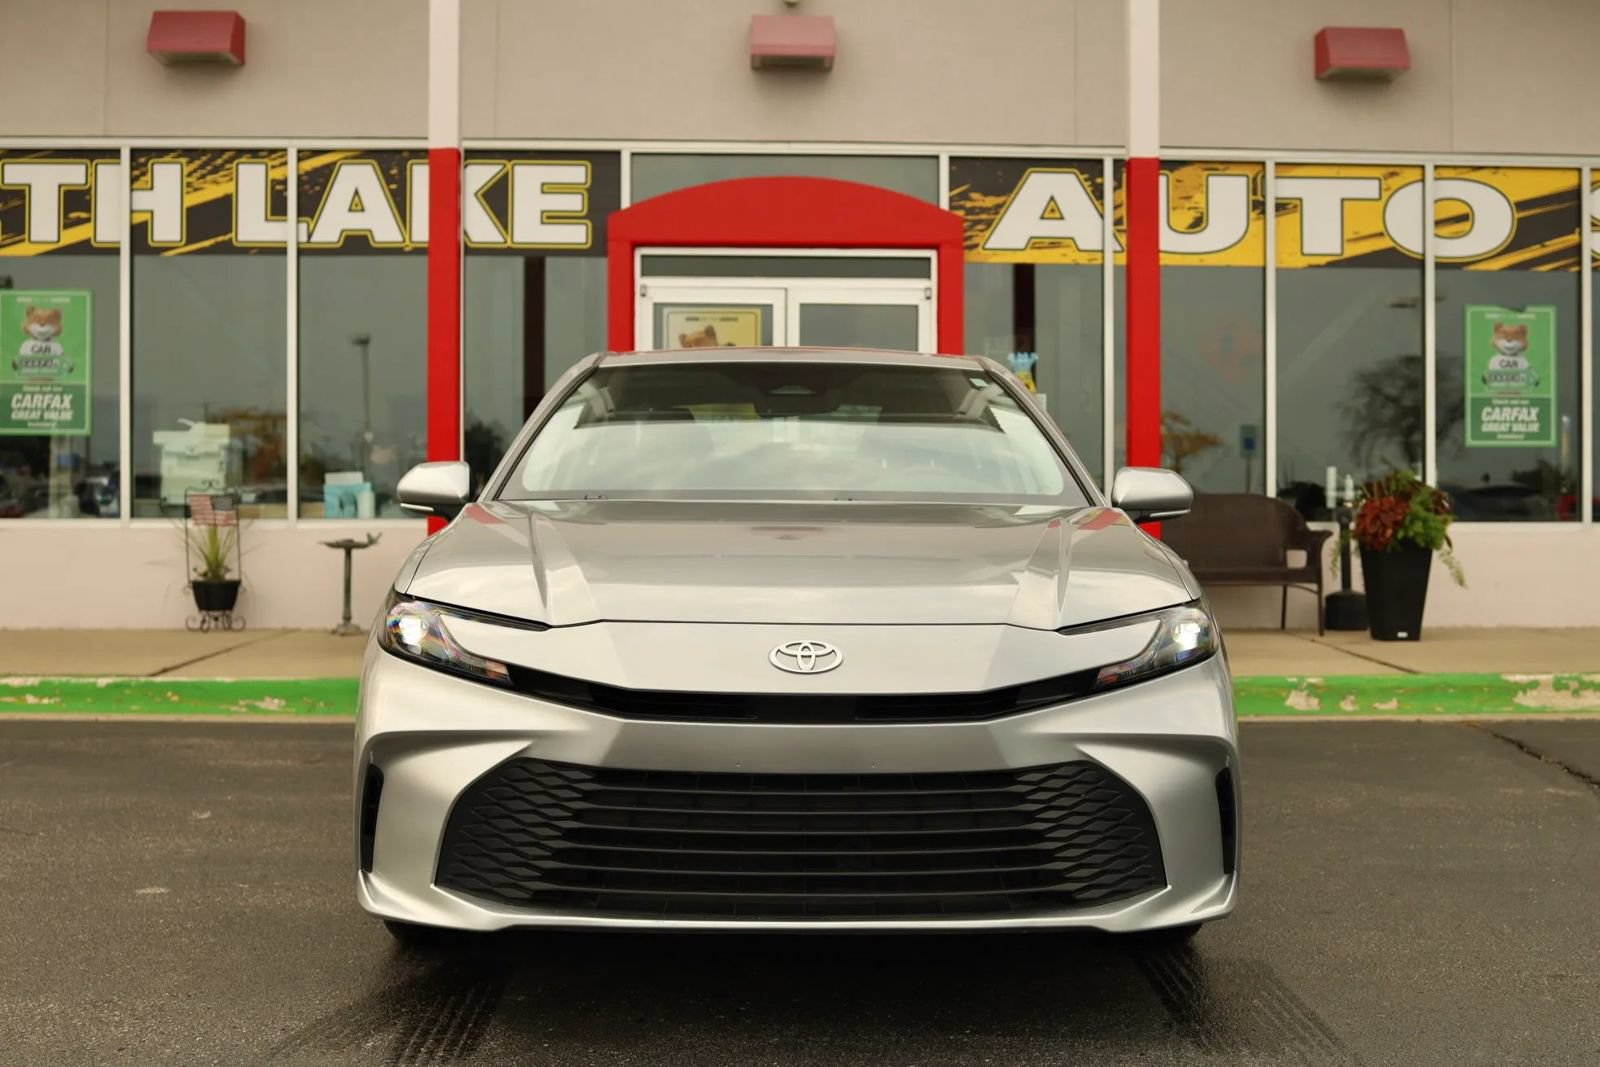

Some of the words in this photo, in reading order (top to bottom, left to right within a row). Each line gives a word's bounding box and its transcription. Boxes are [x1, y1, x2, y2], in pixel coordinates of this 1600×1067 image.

[0, 159, 187, 248] TH
[232, 159, 592, 249] LAKE
[981, 168, 1517, 260] AUTO
[11, 393, 73, 409] CARFAX
[1481, 406, 1539, 421] CARFAX
